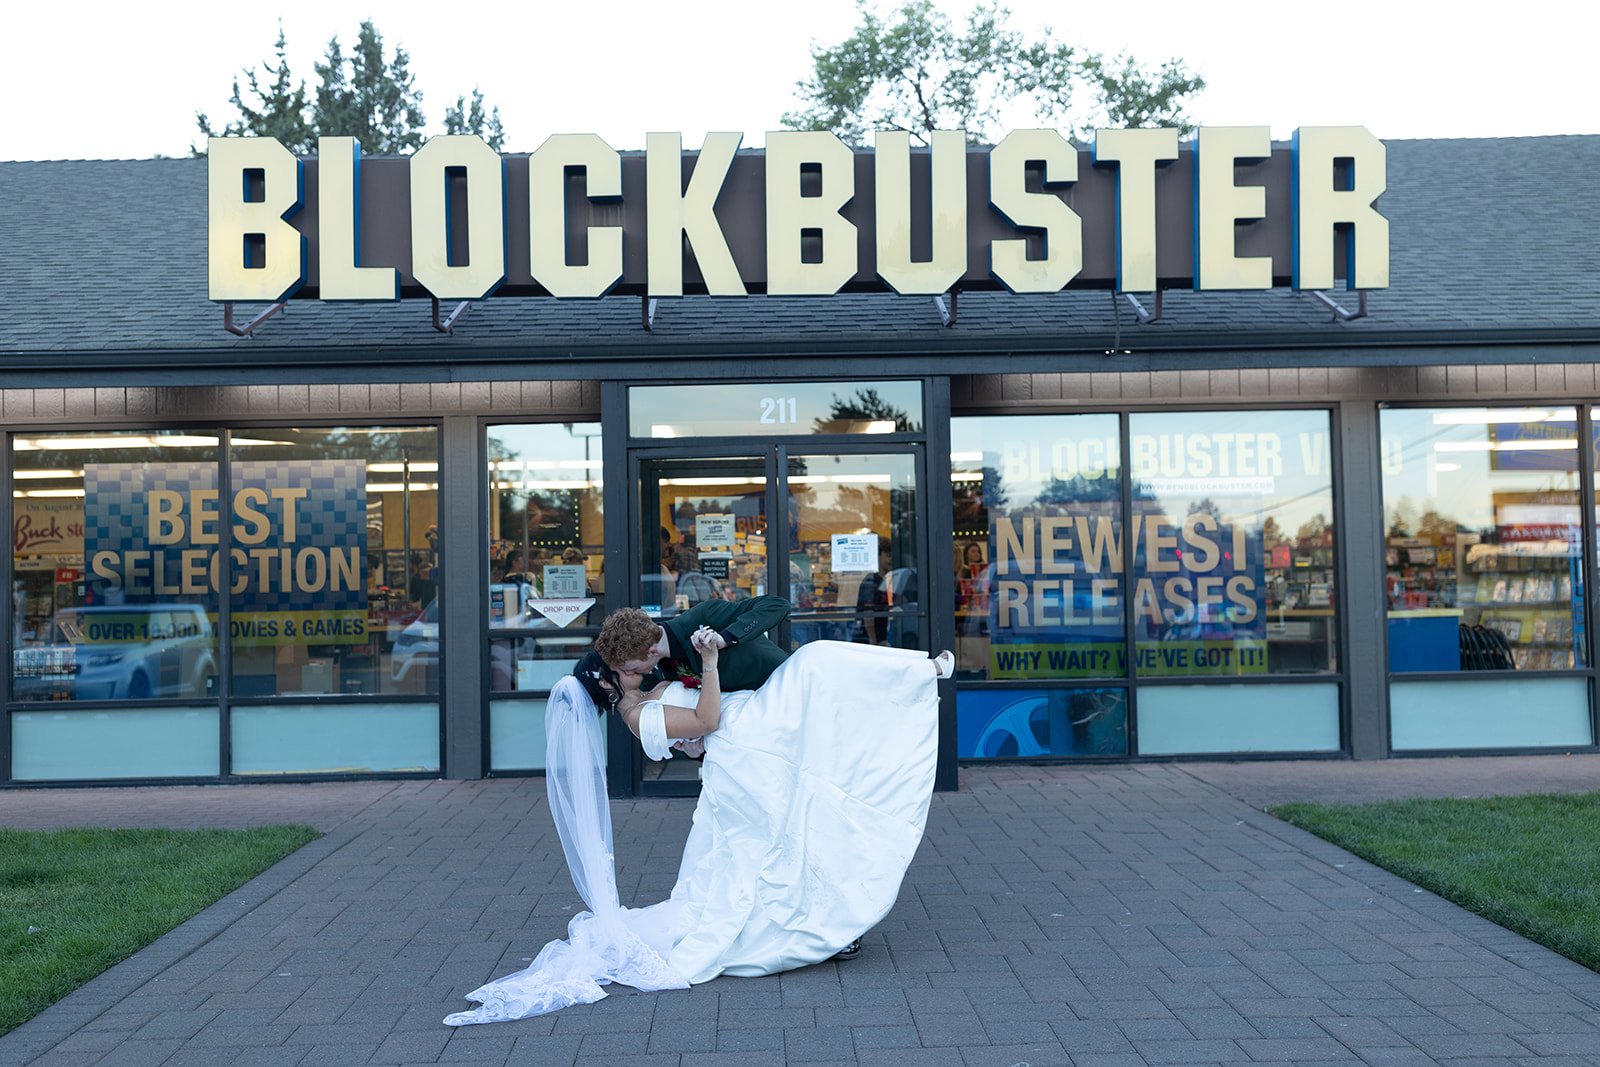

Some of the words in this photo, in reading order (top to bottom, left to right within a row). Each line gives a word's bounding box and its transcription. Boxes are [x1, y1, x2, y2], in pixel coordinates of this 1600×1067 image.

[207, 125, 1391, 302] BLOCKBUSTER
[760, 397, 797, 424] 211
[14, 513, 64, 552] Buck
[148, 487, 307, 545] BEST
[995, 513, 1258, 576] NEWEST
[92, 546, 361, 596] SELECTION
[565, 605, 581, 613] BOX
[998, 575, 1258, 628] RELEASES
[88, 622, 136, 641] OVER
[202, 619, 278, 639] MOVIES
[283, 619, 297, 637] &
[302, 618, 365, 637] GAMES
[996, 651, 1042, 671] WHY
[1047, 650, 1110, 670] WAIT?
[1194, 648, 1233, 668] GOT
[1239, 647, 1264, 667] IT!
